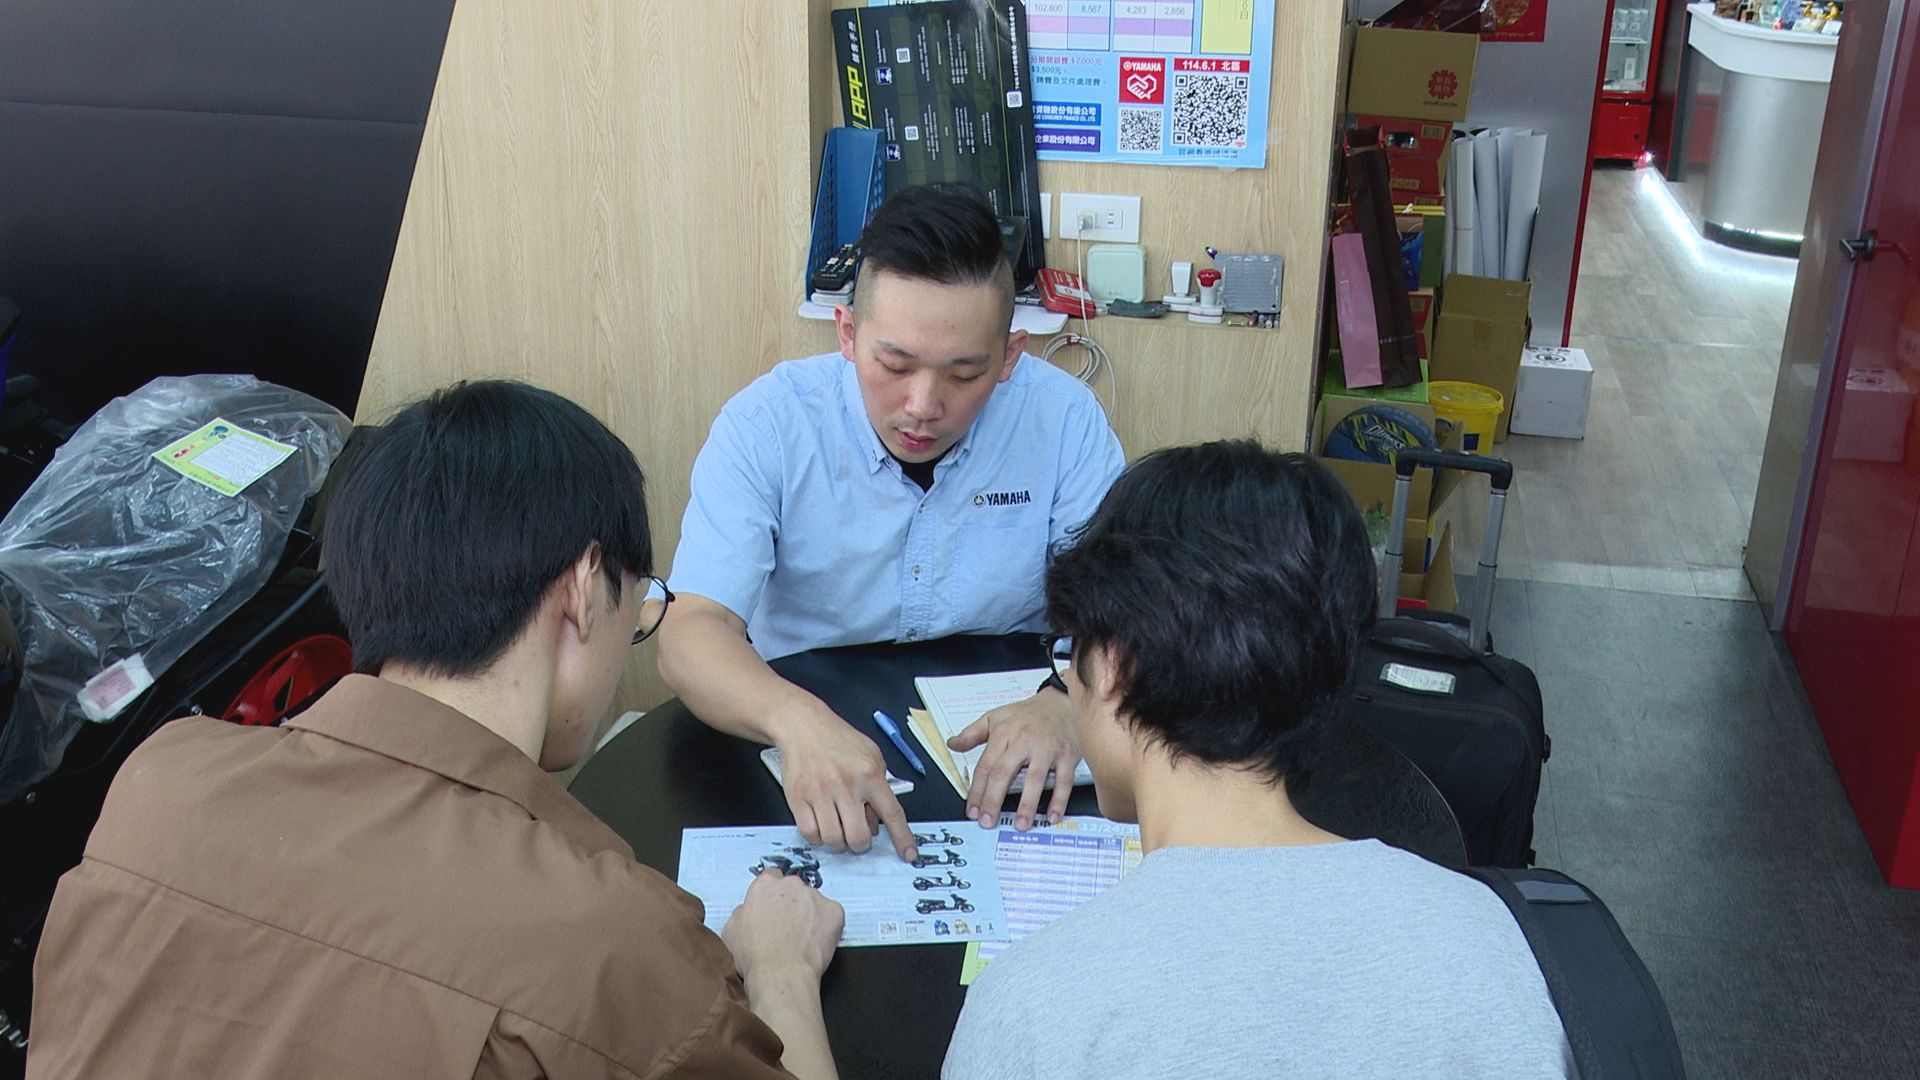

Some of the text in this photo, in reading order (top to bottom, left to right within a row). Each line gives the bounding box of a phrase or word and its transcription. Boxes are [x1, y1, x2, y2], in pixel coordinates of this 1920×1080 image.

[1131, 62, 1162, 72] YAMAHA
[1182, 60, 1216, 71] 114.6.1
[847, 65, 866, 120] APP
[986, 490, 1031, 506] YAMAHA
